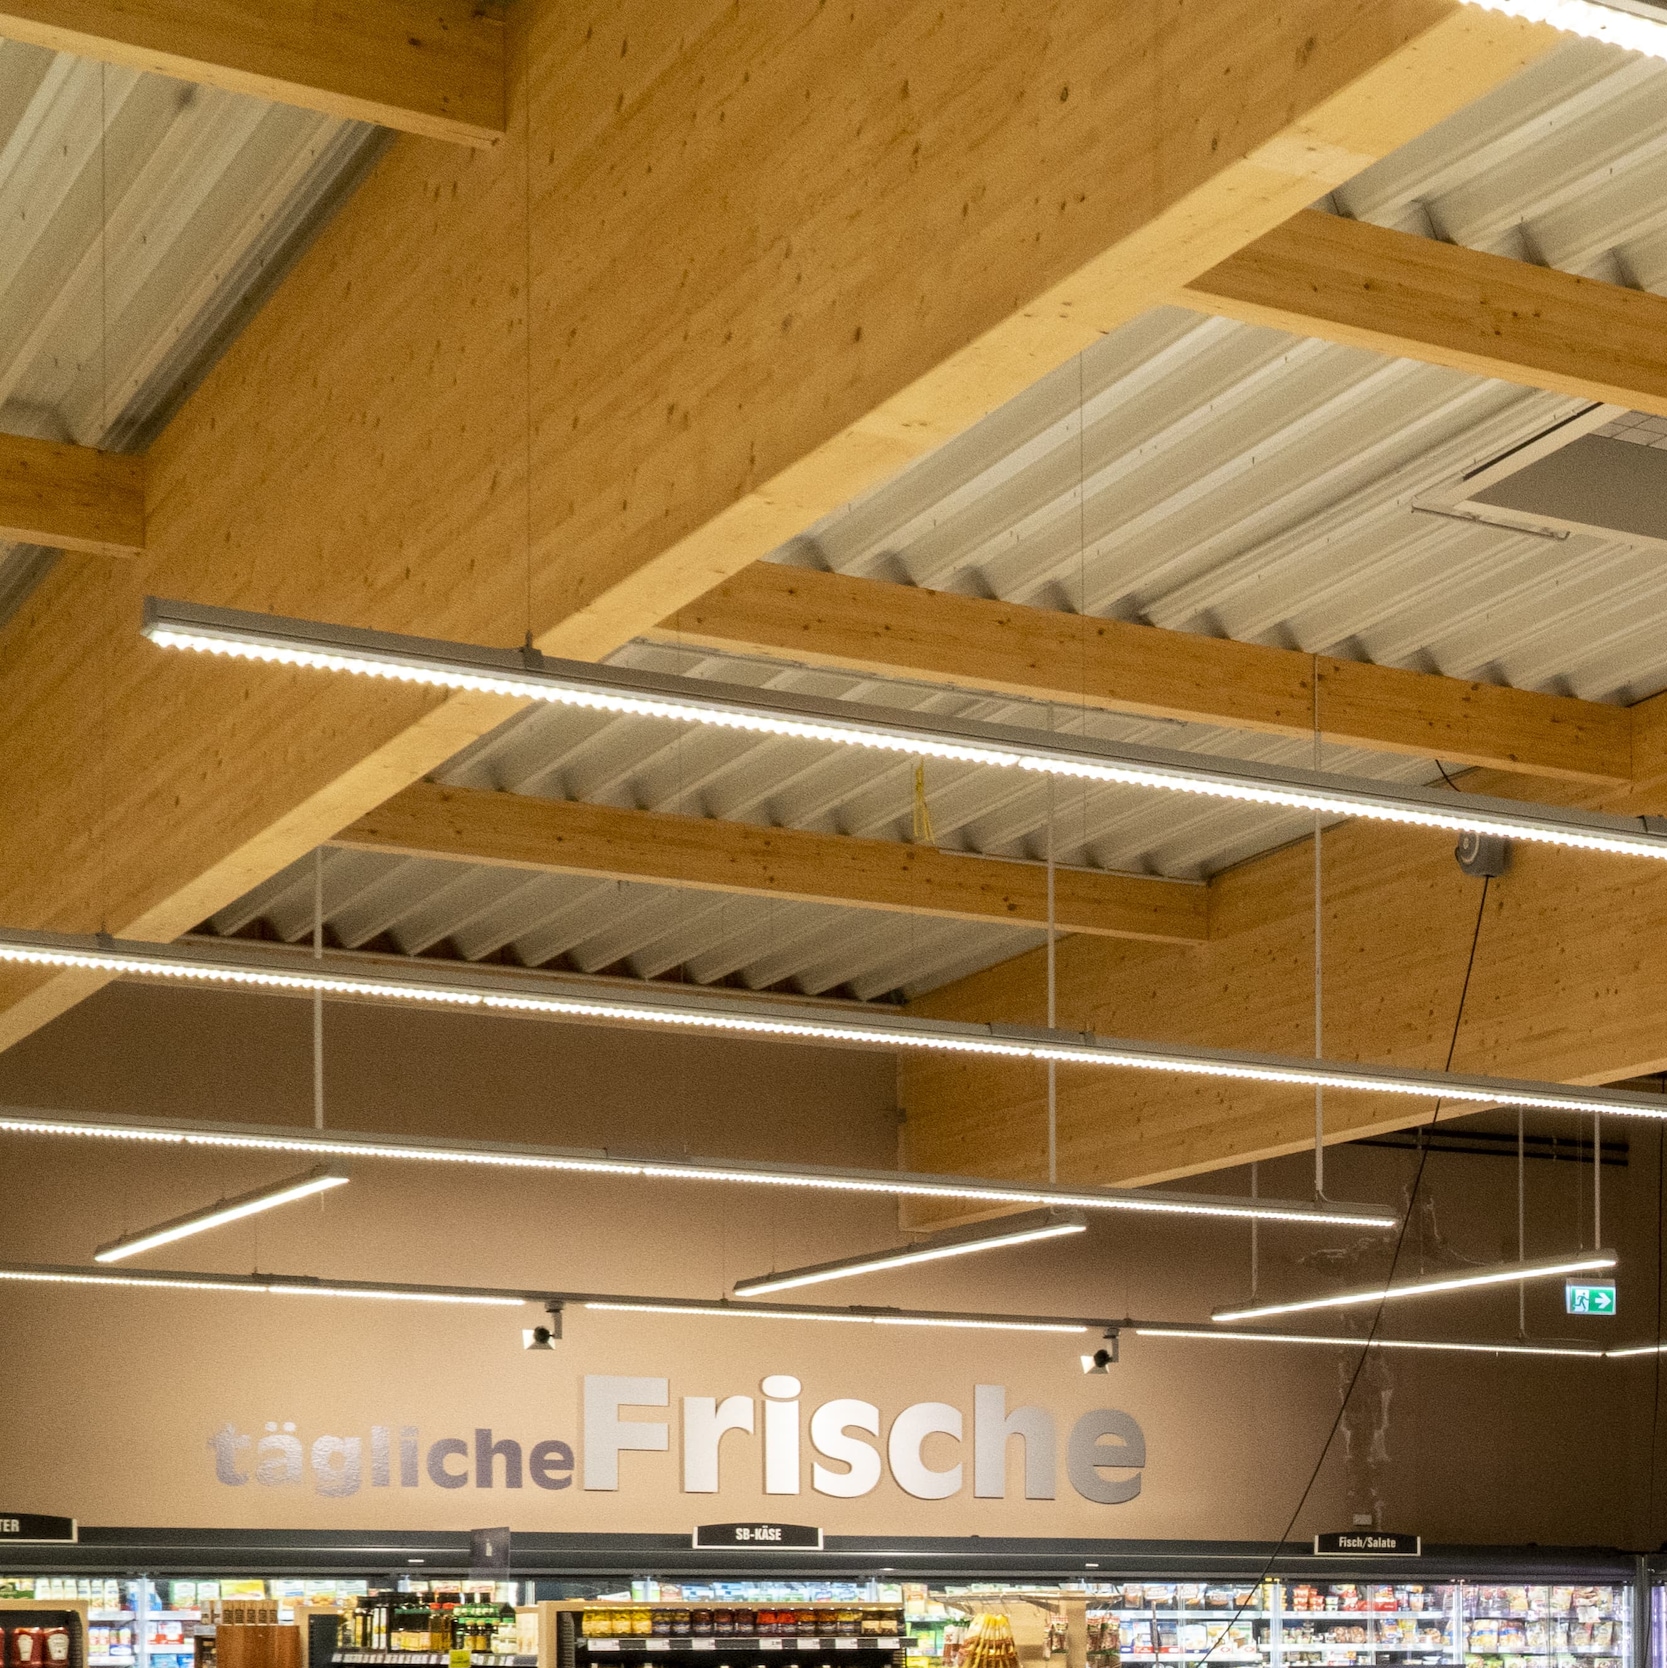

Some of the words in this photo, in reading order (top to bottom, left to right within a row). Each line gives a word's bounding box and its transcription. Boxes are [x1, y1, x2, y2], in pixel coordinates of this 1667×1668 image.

[209, 1420, 576, 1498] tägliche
[583, 1374, 1147, 1505] Frische
[735, 1526, 783, 1541] SB-KÄSE
[1338, 1536, 1397, 1550] Fisch/Salate
